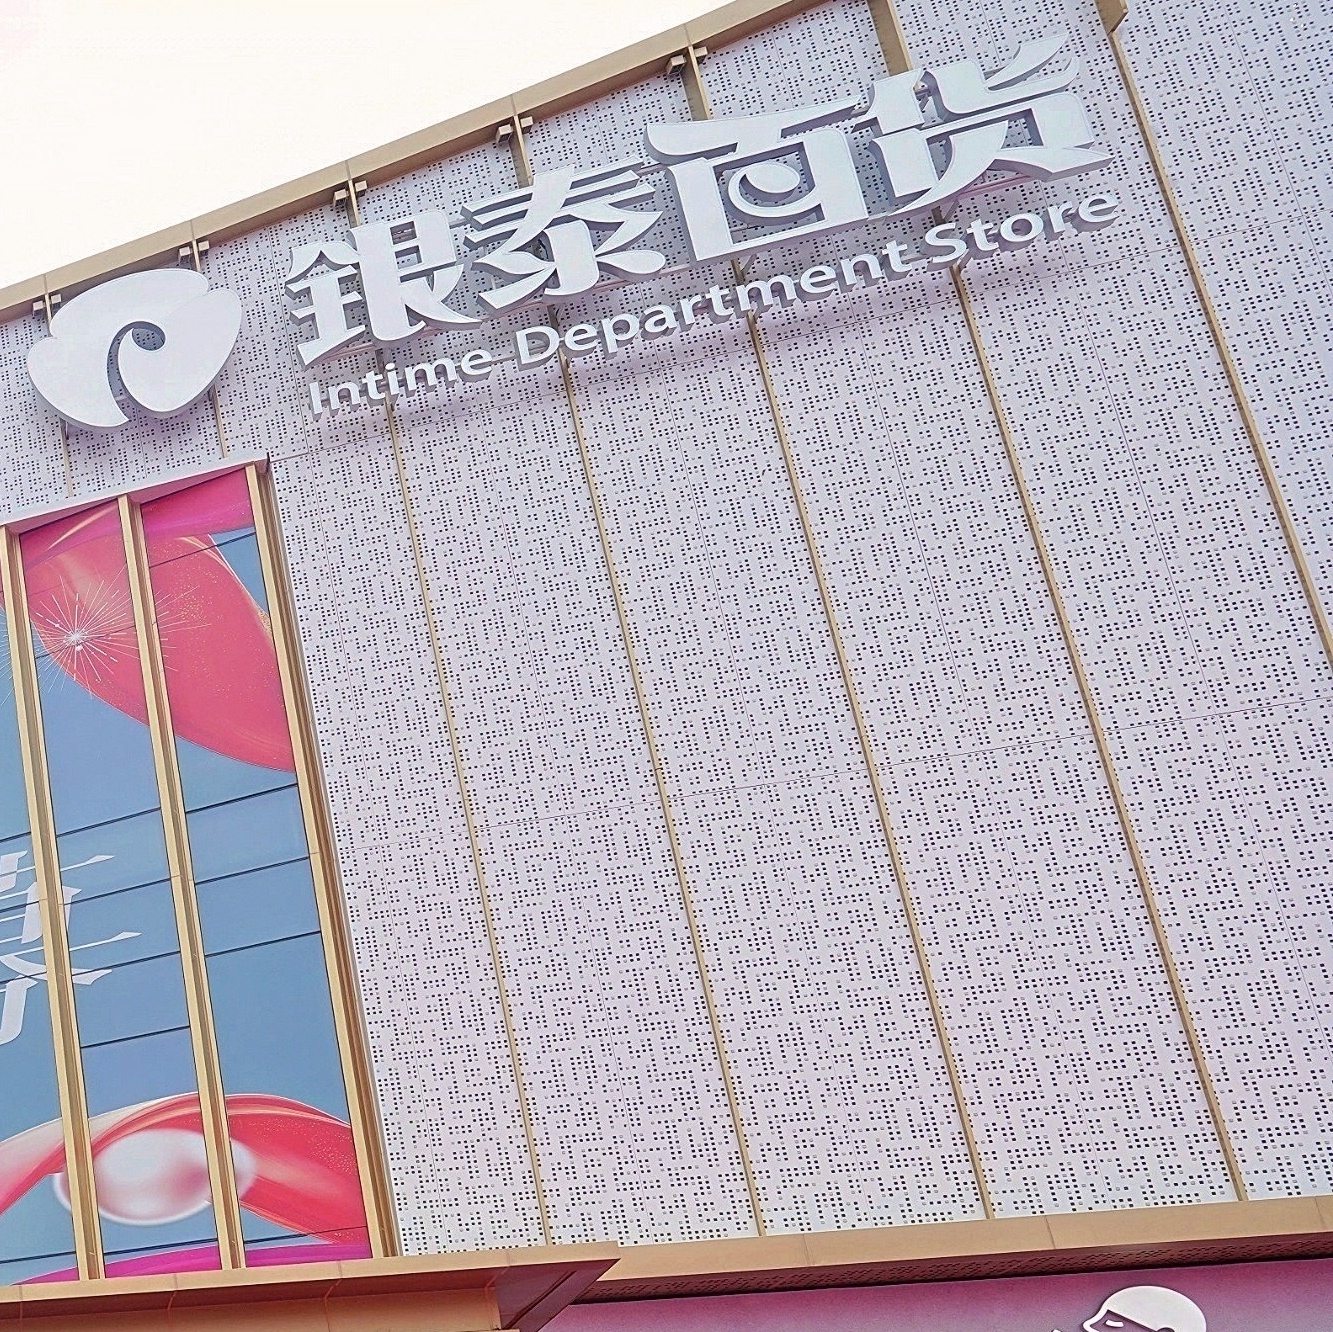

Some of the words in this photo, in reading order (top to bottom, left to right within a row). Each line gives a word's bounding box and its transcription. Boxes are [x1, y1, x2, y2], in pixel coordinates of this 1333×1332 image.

[284, 30, 1117, 367] 银泰百货
[308, 346, 494, 420] Intime
[514, 243, 911, 366] Department
[926, 187, 1120, 265] Store
